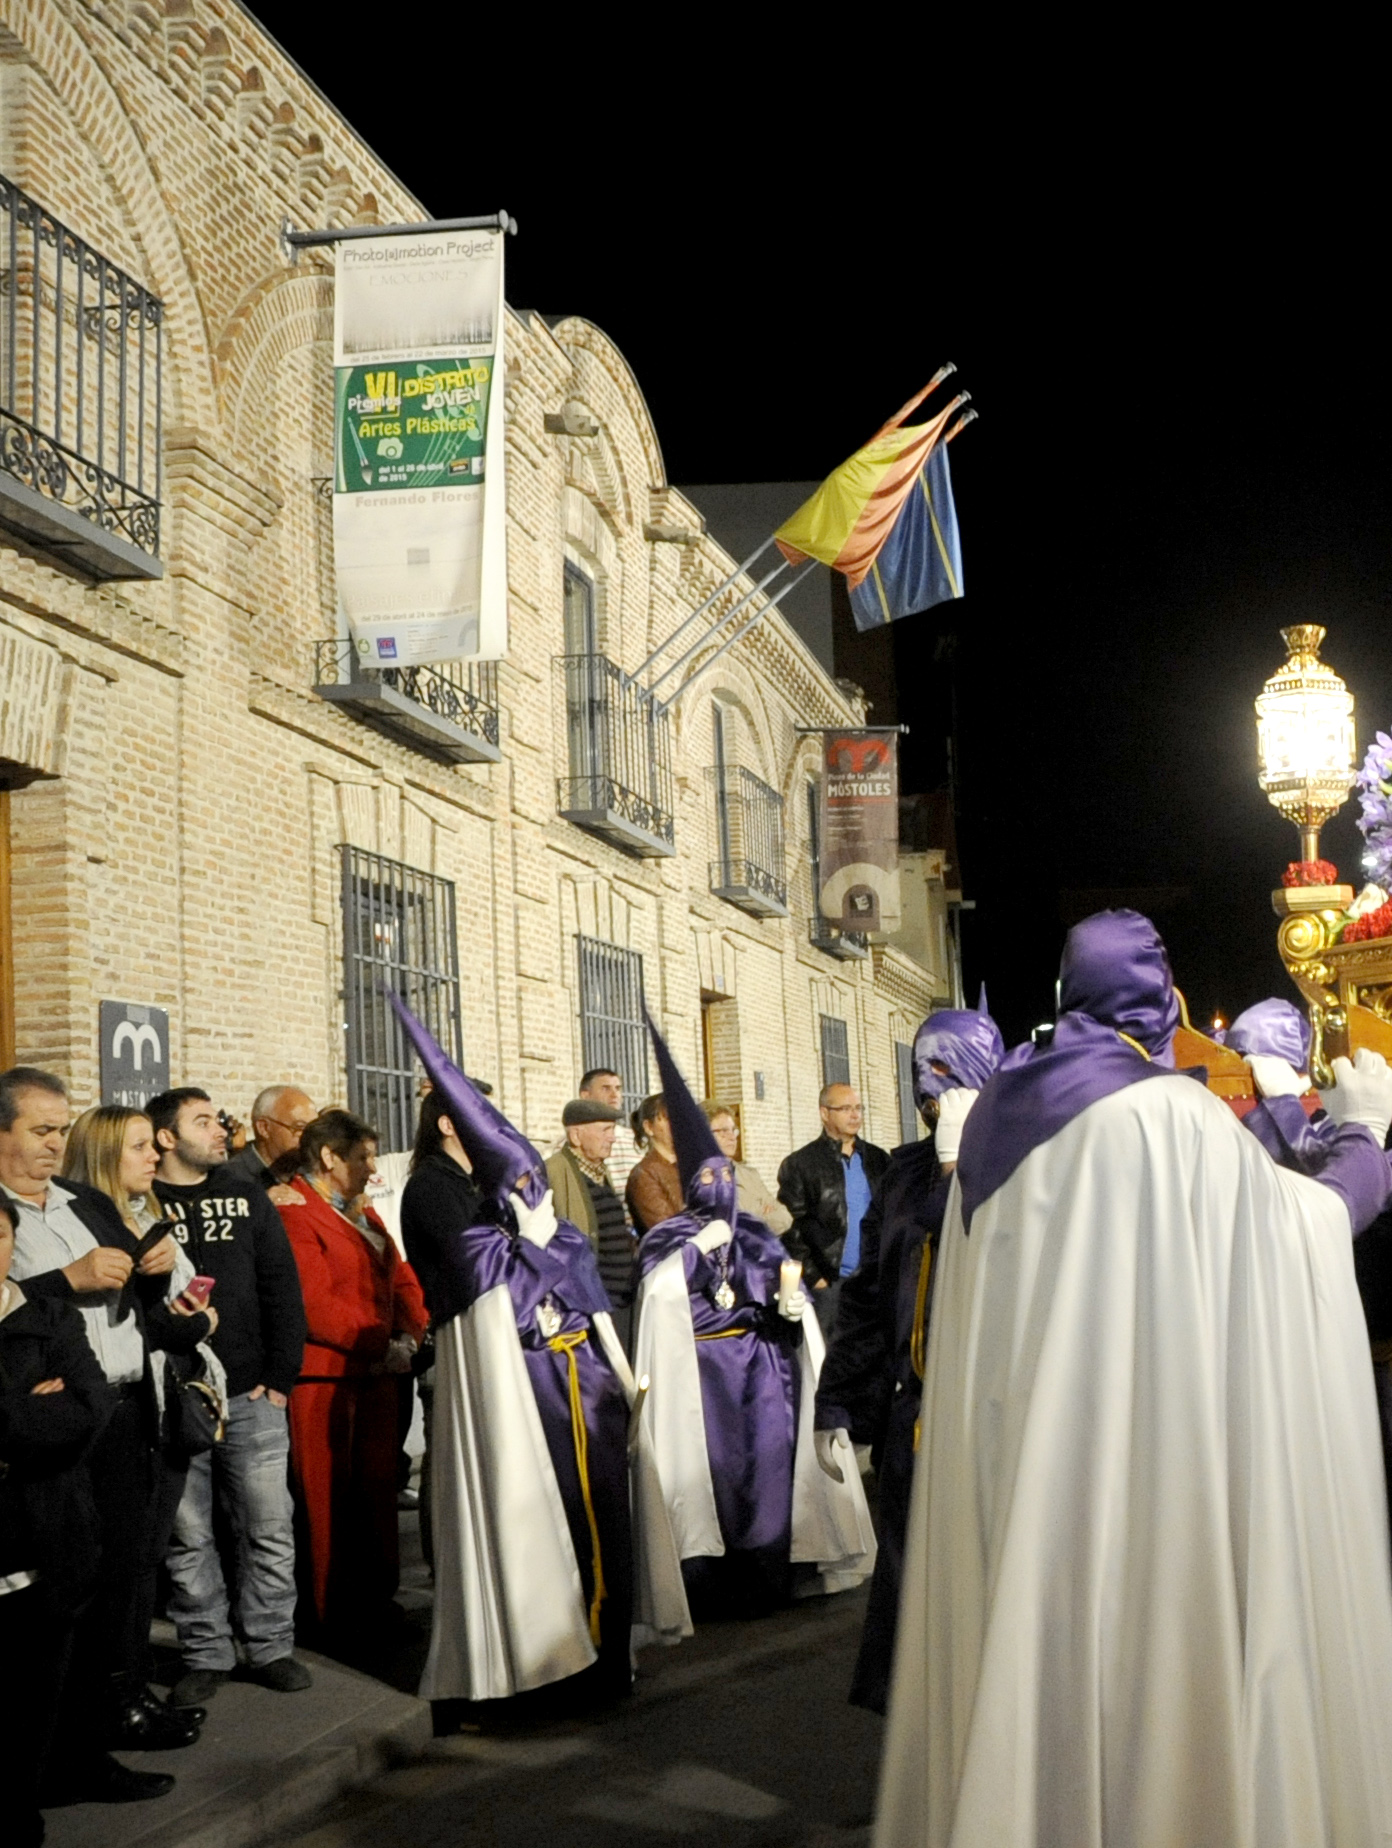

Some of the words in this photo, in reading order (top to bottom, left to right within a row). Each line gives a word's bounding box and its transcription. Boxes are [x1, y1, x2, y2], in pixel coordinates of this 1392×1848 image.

[446, 239, 494, 257] Project
[365, 372, 396, 413] VI
[403, 366, 489, 397] DISTRITO
[421, 385, 481, 411] JOVEN
[359, 421, 402, 438] Artes
[406, 416, 476, 435] Plásticas
[355, 493, 426, 508] Fernando
[432, 491, 479, 504] Flores
[827, 781, 891, 797] MÓSTOLES
